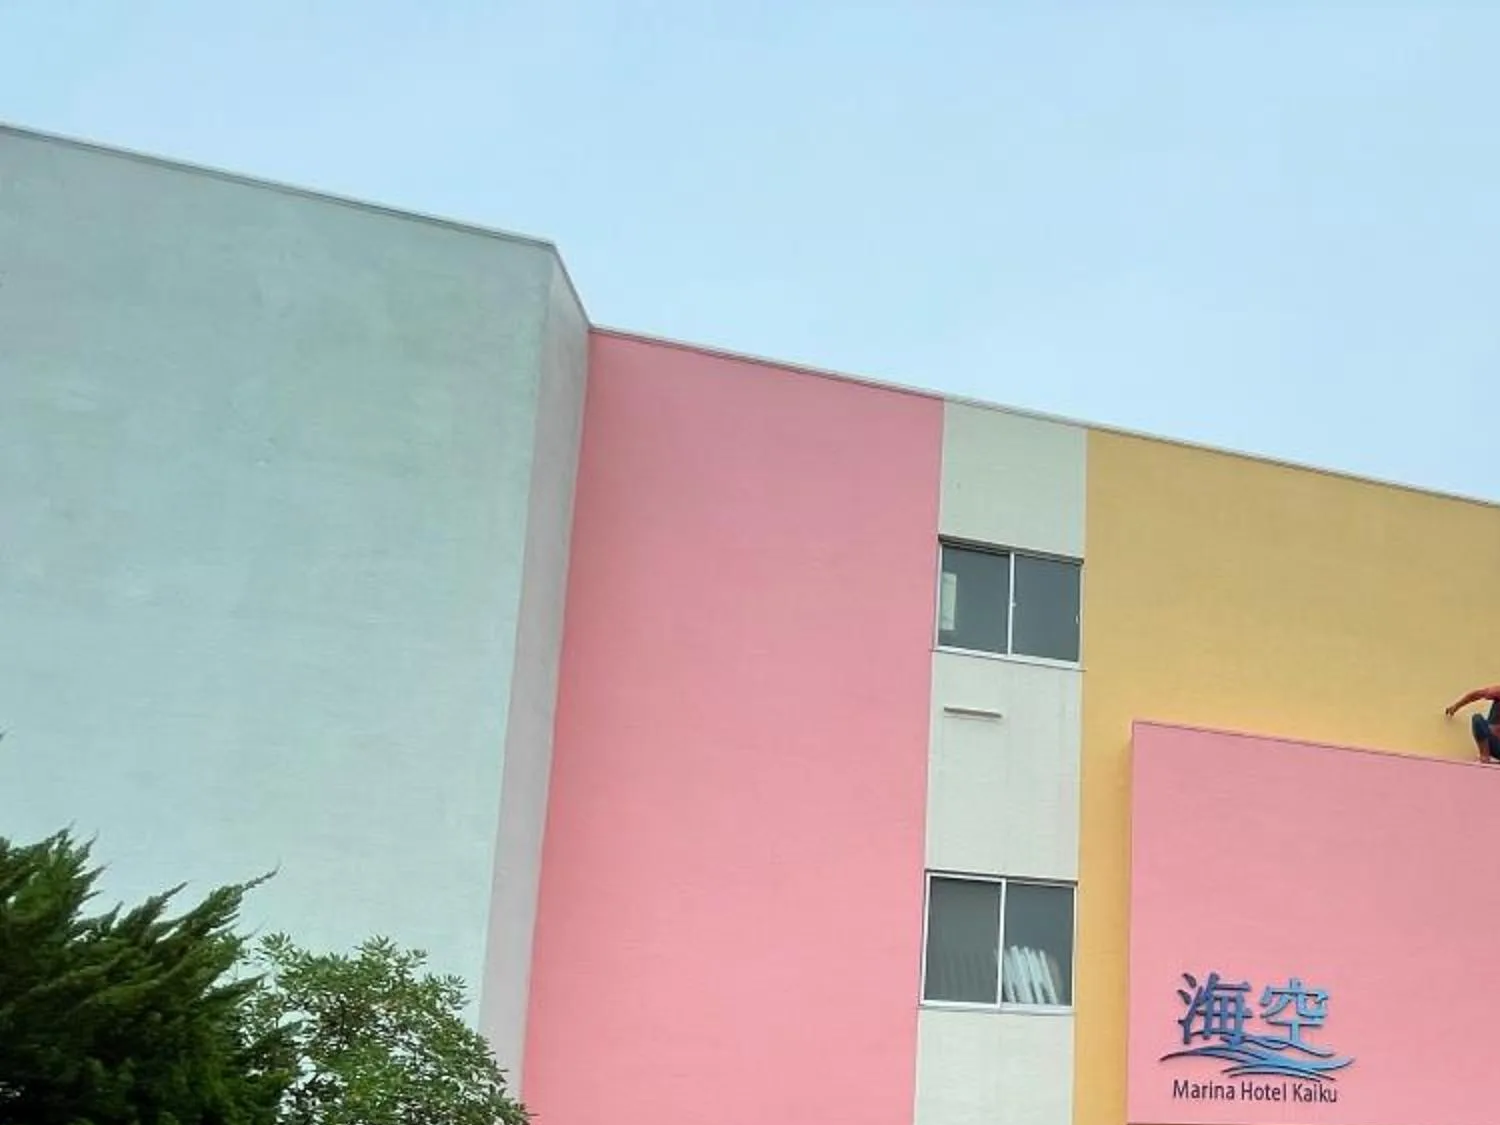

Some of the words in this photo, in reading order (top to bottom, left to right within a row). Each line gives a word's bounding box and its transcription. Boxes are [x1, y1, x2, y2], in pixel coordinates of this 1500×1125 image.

[1177, 971, 1329, 1046] 海空
[1172, 1079, 1236, 1101] Marina
[1241, 1081, 1287, 1102] Hotel
[1292, 1082, 1338, 1104] Kaiku
